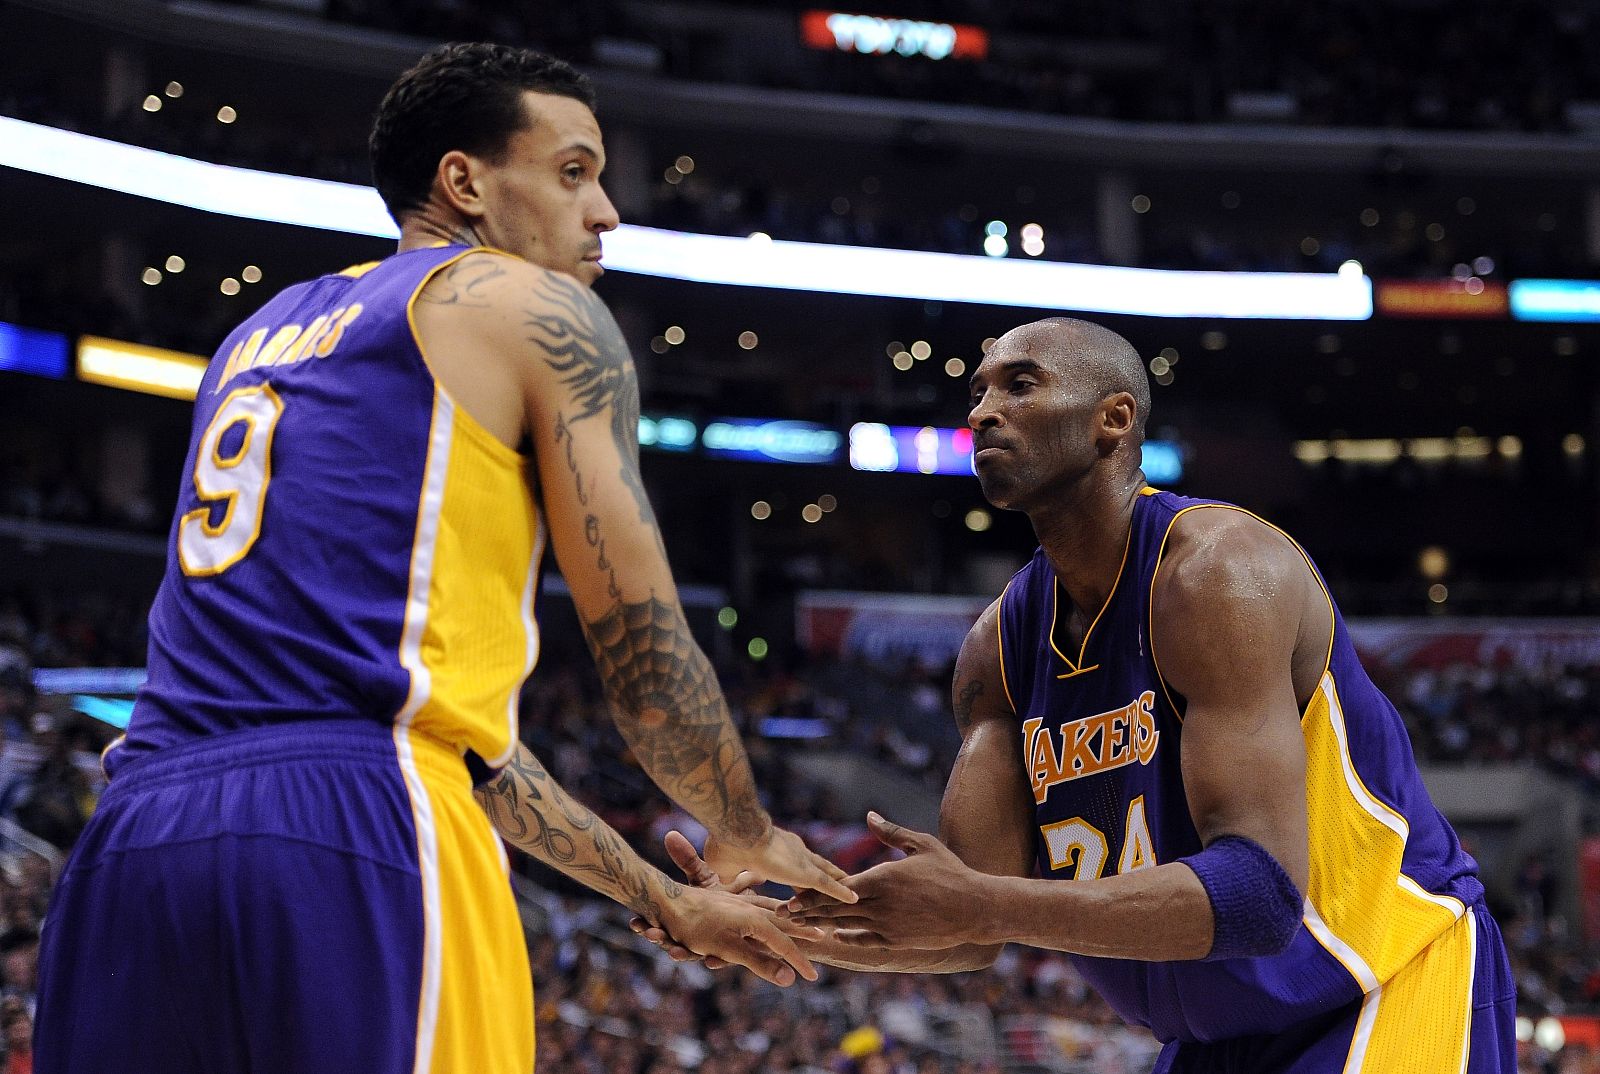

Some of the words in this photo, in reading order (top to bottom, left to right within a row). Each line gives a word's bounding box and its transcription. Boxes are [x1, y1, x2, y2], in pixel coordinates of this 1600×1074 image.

[178, 380, 286, 577] 9
[1021, 690, 1160, 806] LAKERS
[1040, 794, 1157, 881] 24
